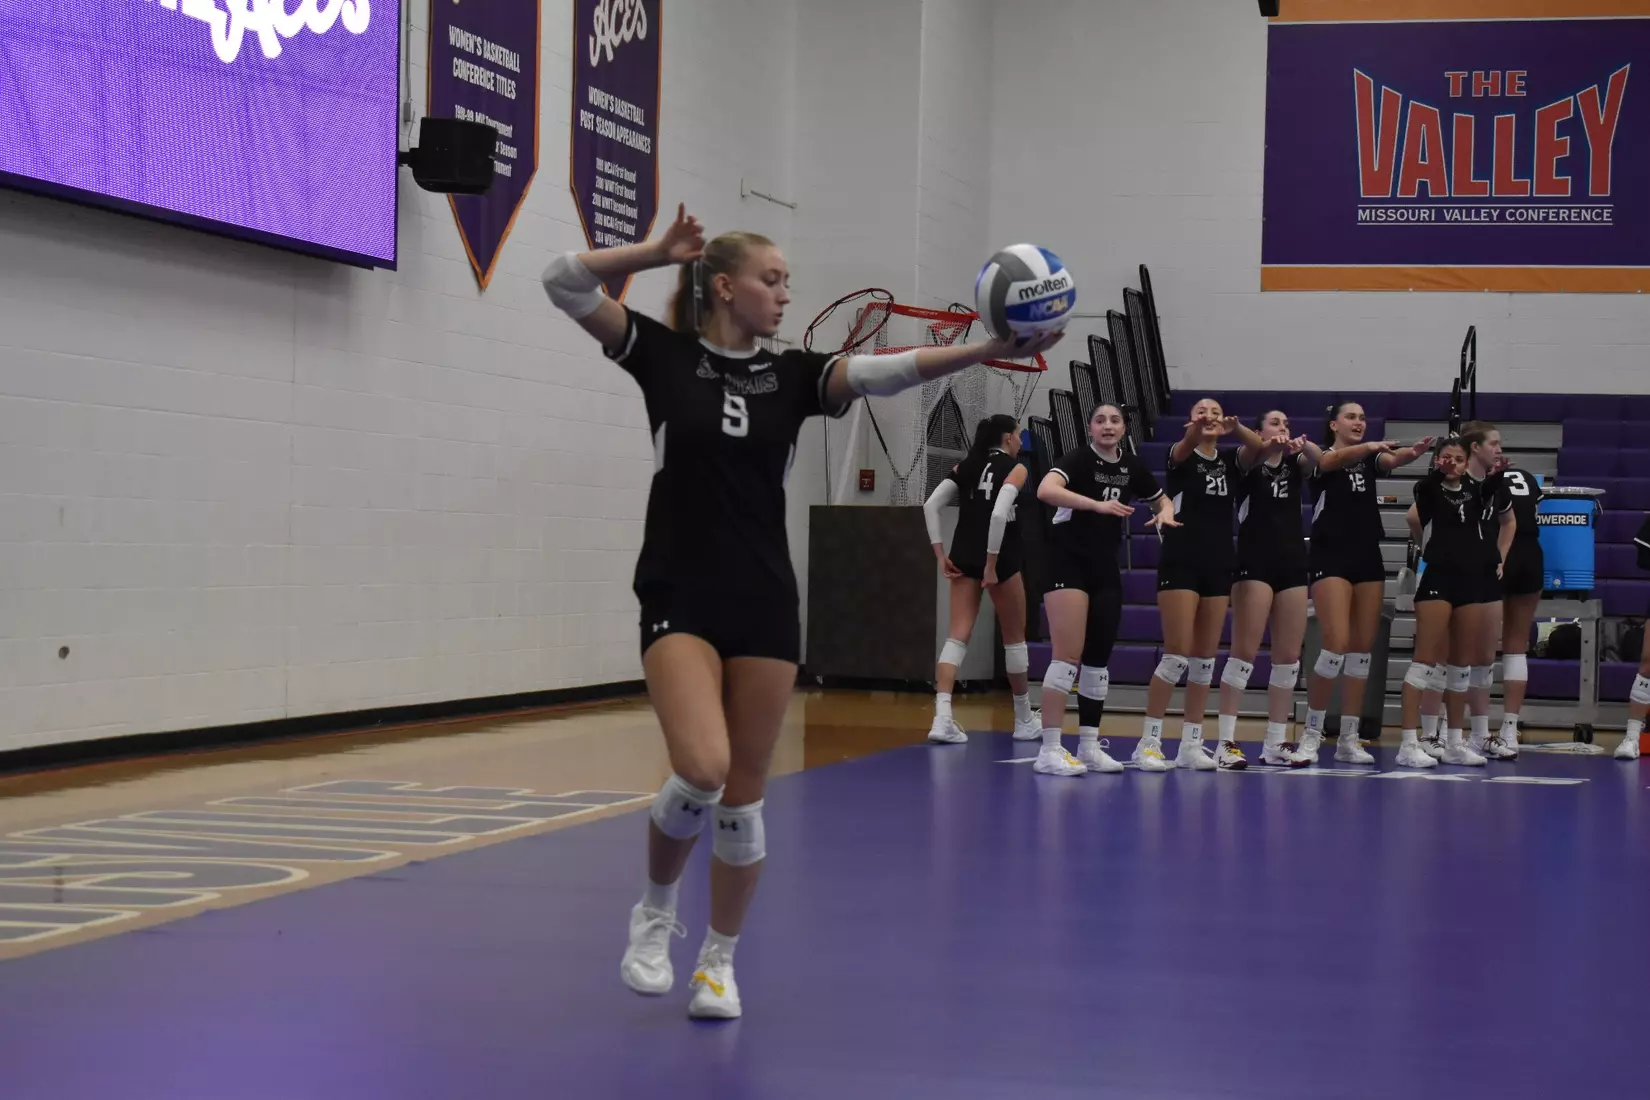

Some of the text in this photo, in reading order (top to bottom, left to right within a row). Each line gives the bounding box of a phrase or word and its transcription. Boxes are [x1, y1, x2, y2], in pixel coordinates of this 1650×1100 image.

[449, 24, 520, 73] WOMEN'S BASKETBALL
[453, 57, 516, 100] CONFERENCE TITLES
[1444, 71, 1527, 97] THE
[588, 85, 644, 126] WOMEN'S BASKETBALL
[580, 109, 651, 154] POST SEASON APPEARANCES
[1354, 63, 1631, 198] VALLEY
[1357, 209, 1612, 221] MISSOURI VALLEY CONFERENCE
[1019, 277, 1069, 301] molten
[1029, 295, 1069, 320] NCAA
[977, 462, 994, 500] 4
[1205, 475, 1228, 496] 20
[1271, 480, 1289, 498] 12
[1349, 473, 1366, 492] 15
[1503, 471, 1530, 496] 3
[1536, 514, 1587, 525] OWERADE
